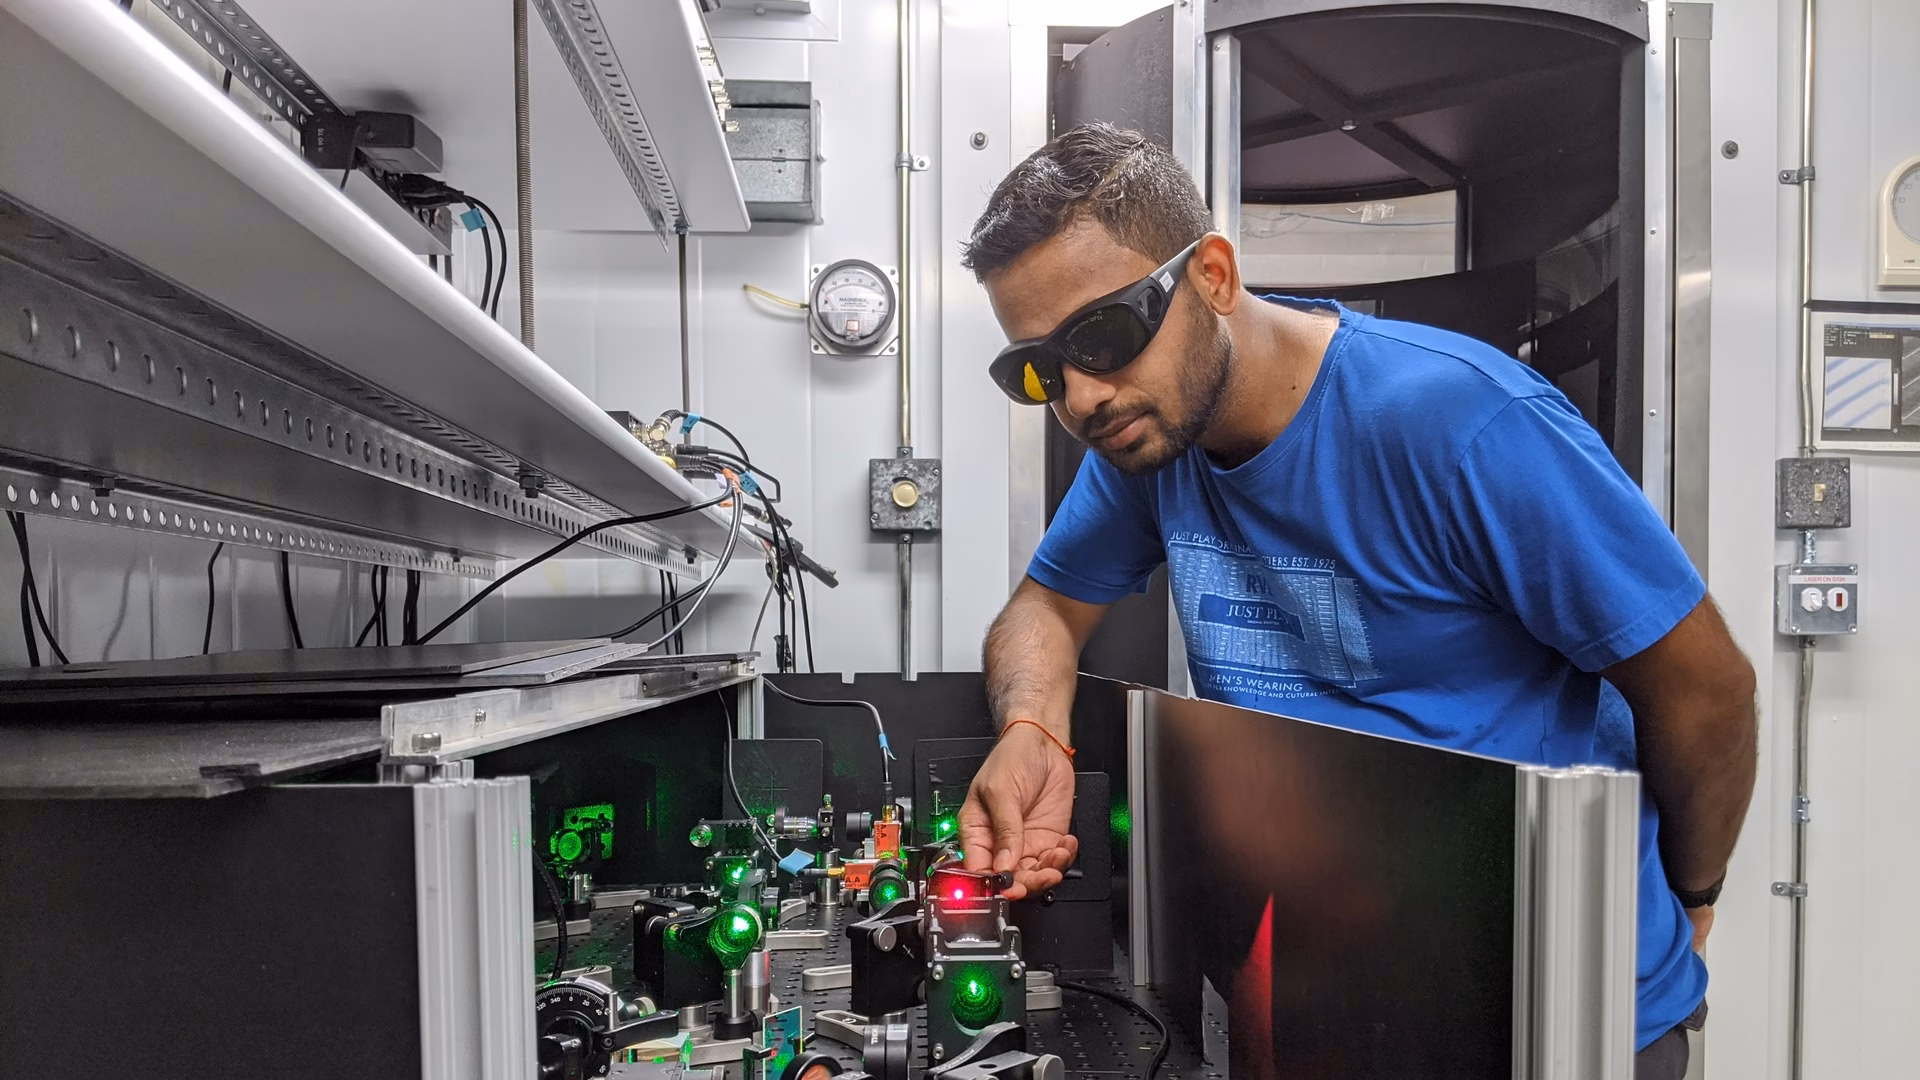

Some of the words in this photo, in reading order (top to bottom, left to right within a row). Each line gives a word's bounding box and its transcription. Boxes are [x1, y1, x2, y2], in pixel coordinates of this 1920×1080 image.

[1170, 531, 1191, 541] JUST
[1192, 533, 1216, 545] PLAY
[1291, 556, 1309, 569] EST.
[1313, 558, 1336, 570] 1975
[1225, 604, 1264, 619] JUST
[1223, 686, 1267, 697] KNOWLEDGE
[1246, 678, 1303, 692] WEARING
